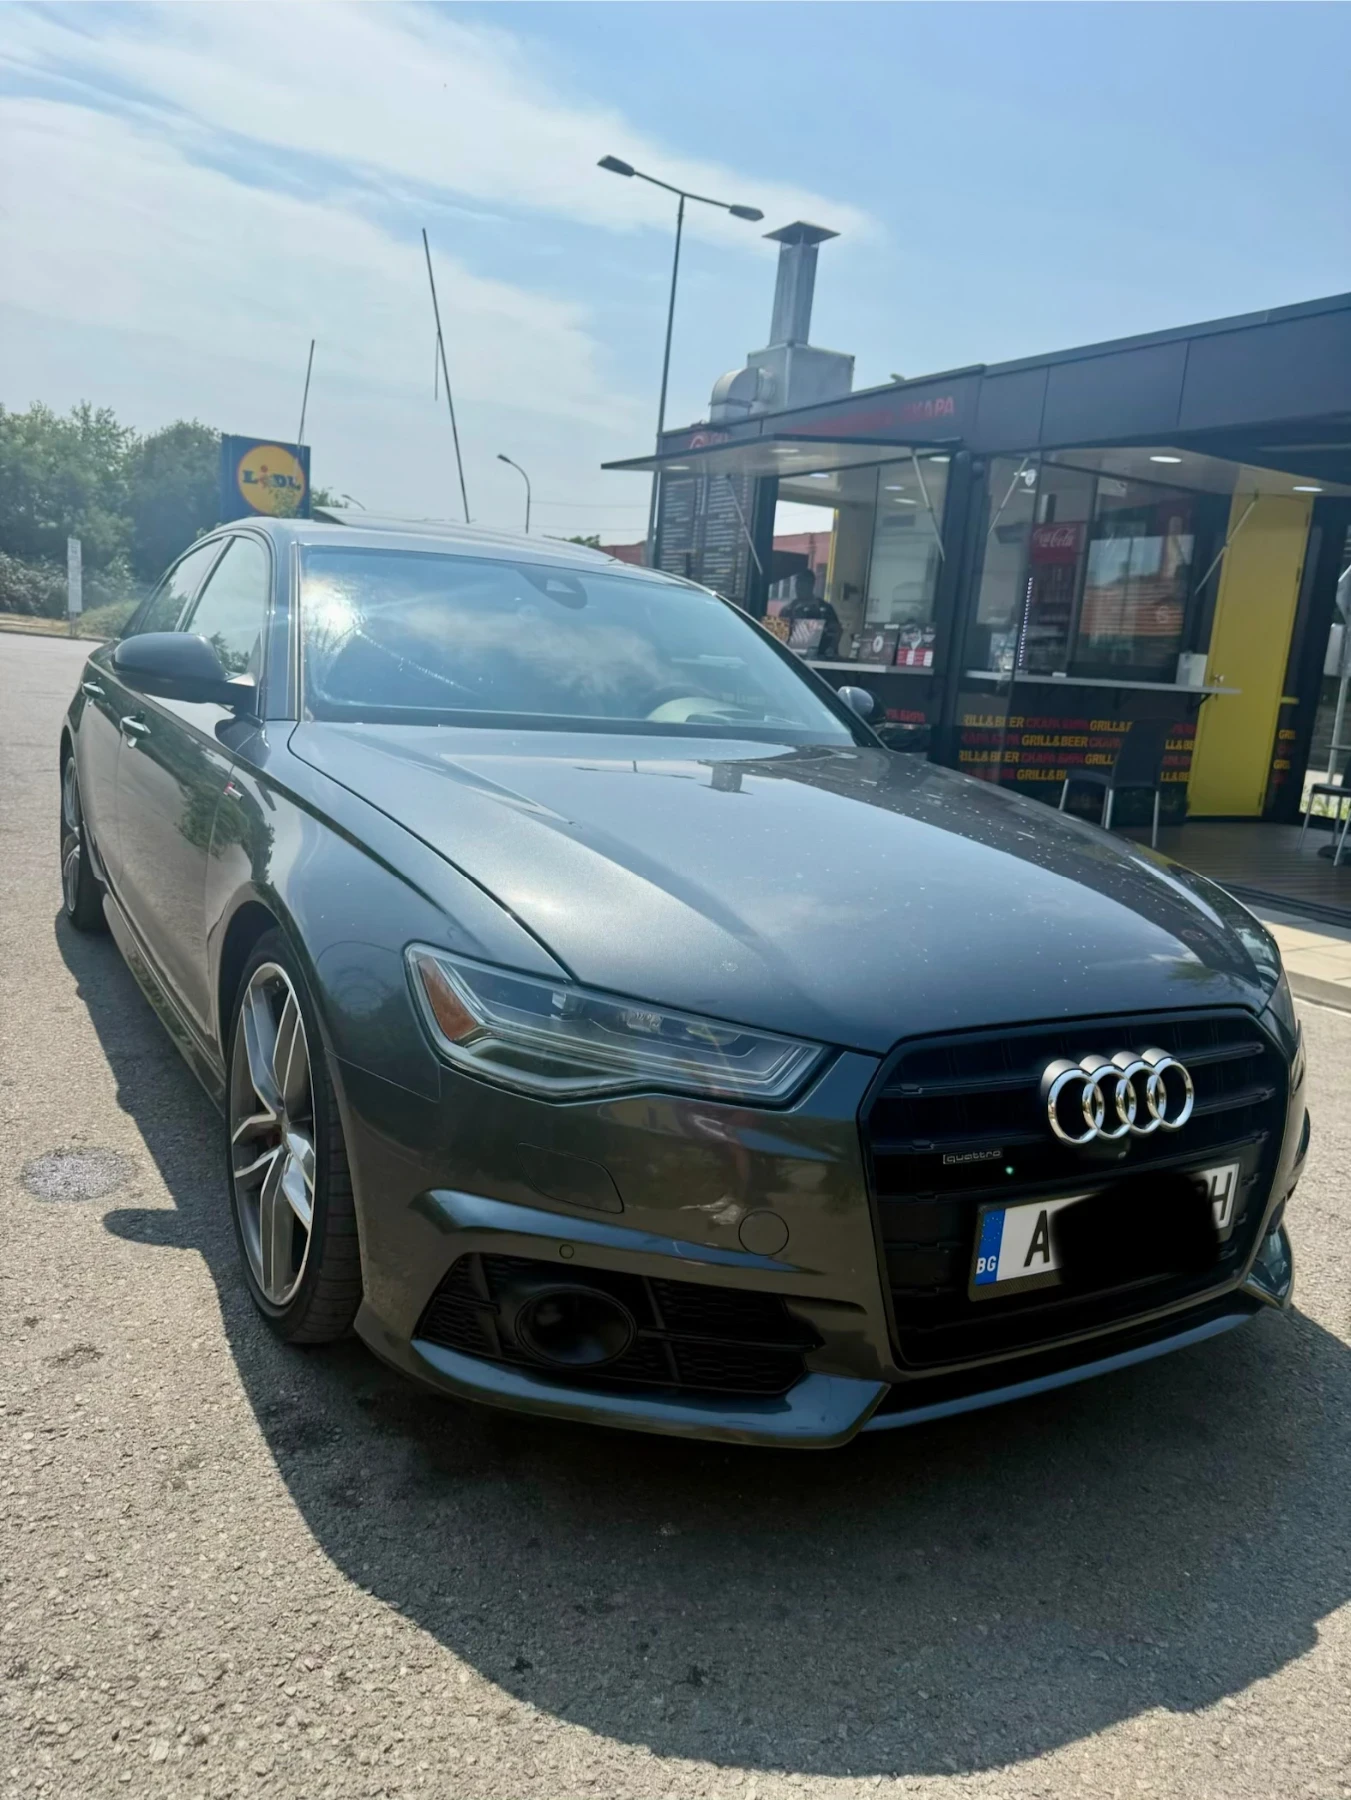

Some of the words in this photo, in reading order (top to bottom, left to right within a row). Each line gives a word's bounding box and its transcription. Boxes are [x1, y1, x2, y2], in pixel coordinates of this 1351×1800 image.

[1022, 734, 1088, 748] GRILL&BEER
[943, 1150, 1001, 1163] quattro
[1205, 1171, 1233, 1222] H
[976, 1255, 997, 1274] BG
